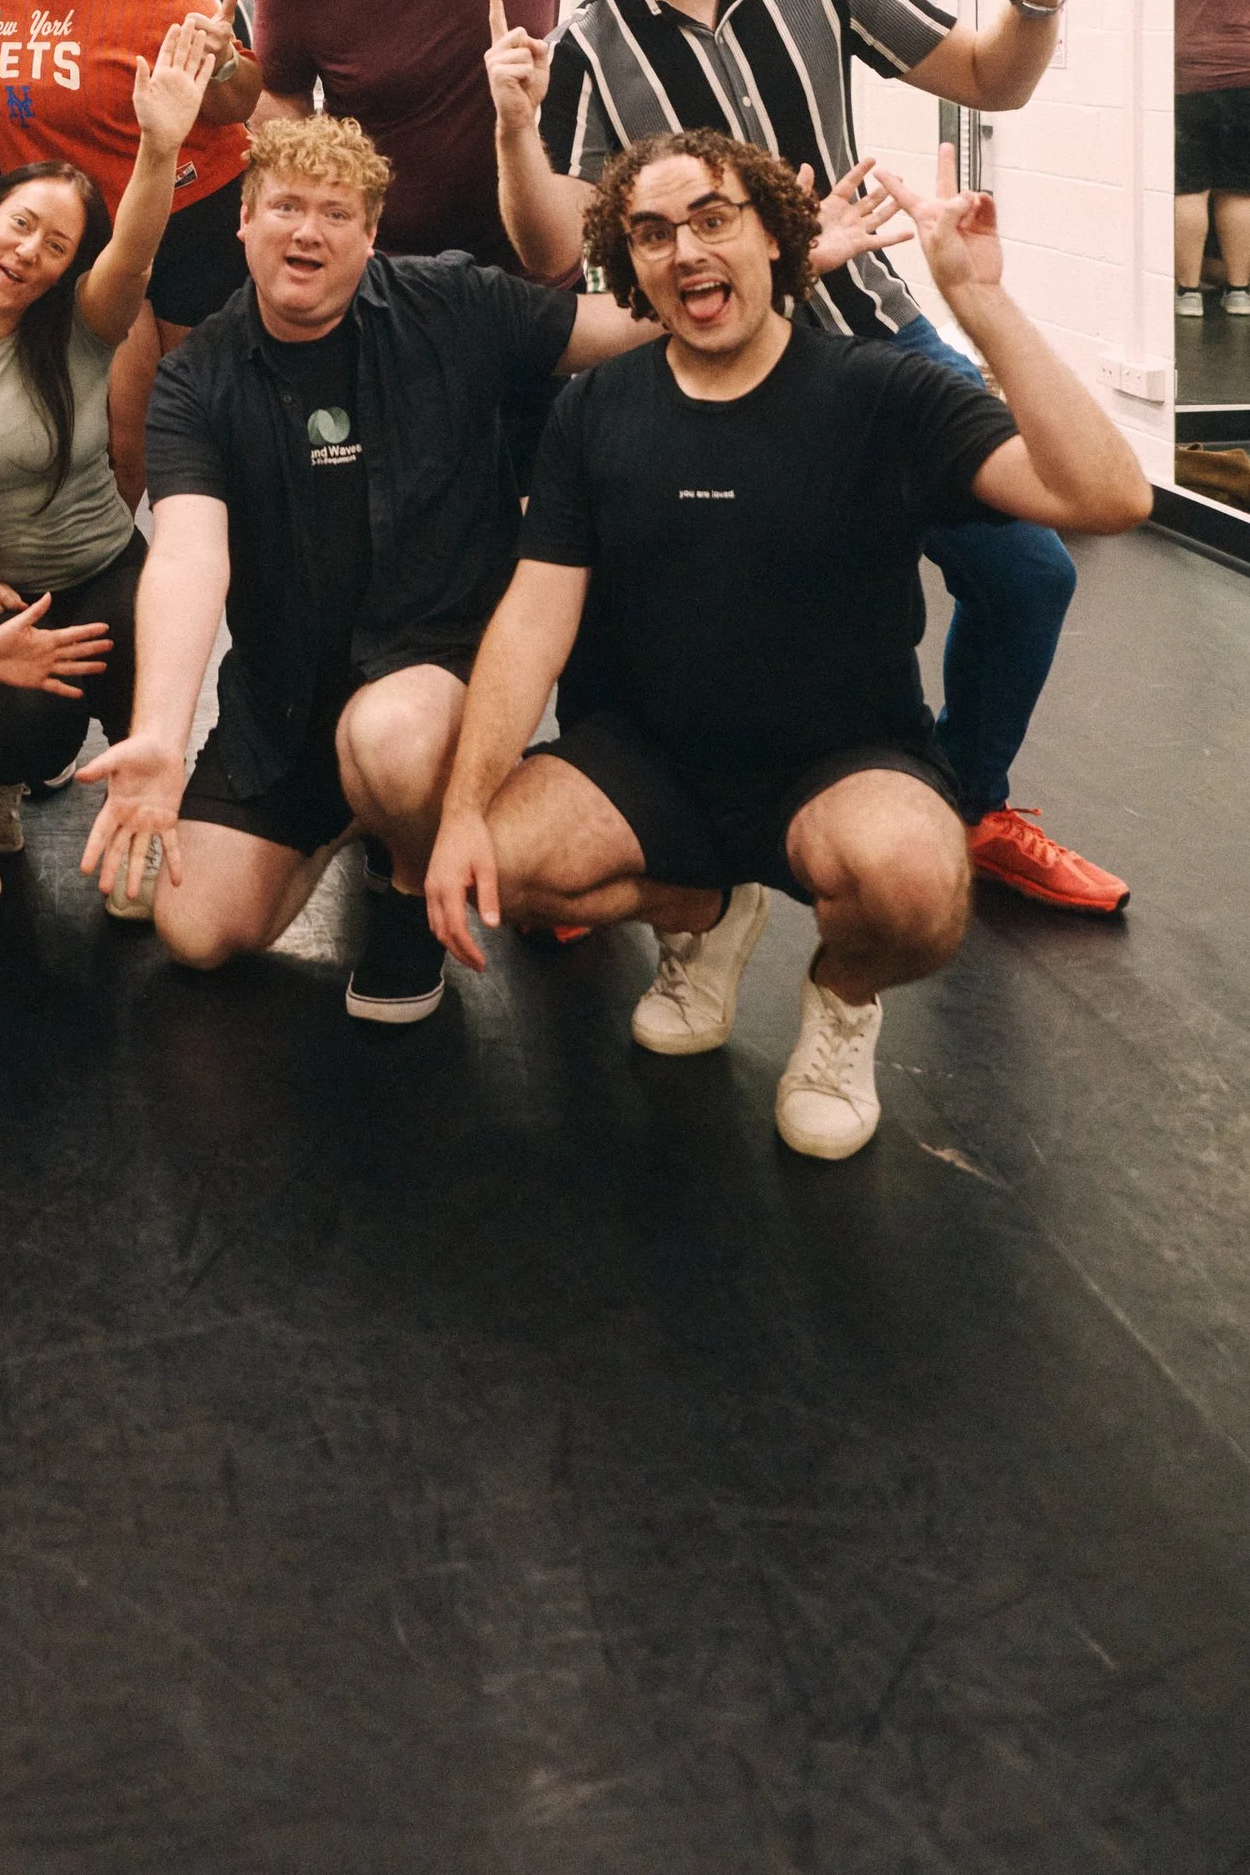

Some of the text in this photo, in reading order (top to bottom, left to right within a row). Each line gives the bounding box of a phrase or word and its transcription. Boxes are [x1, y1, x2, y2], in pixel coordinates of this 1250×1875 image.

[30, 9, 75, 43] York
[678, 489, 695, 499] you
[696, 490, 710, 499] are
